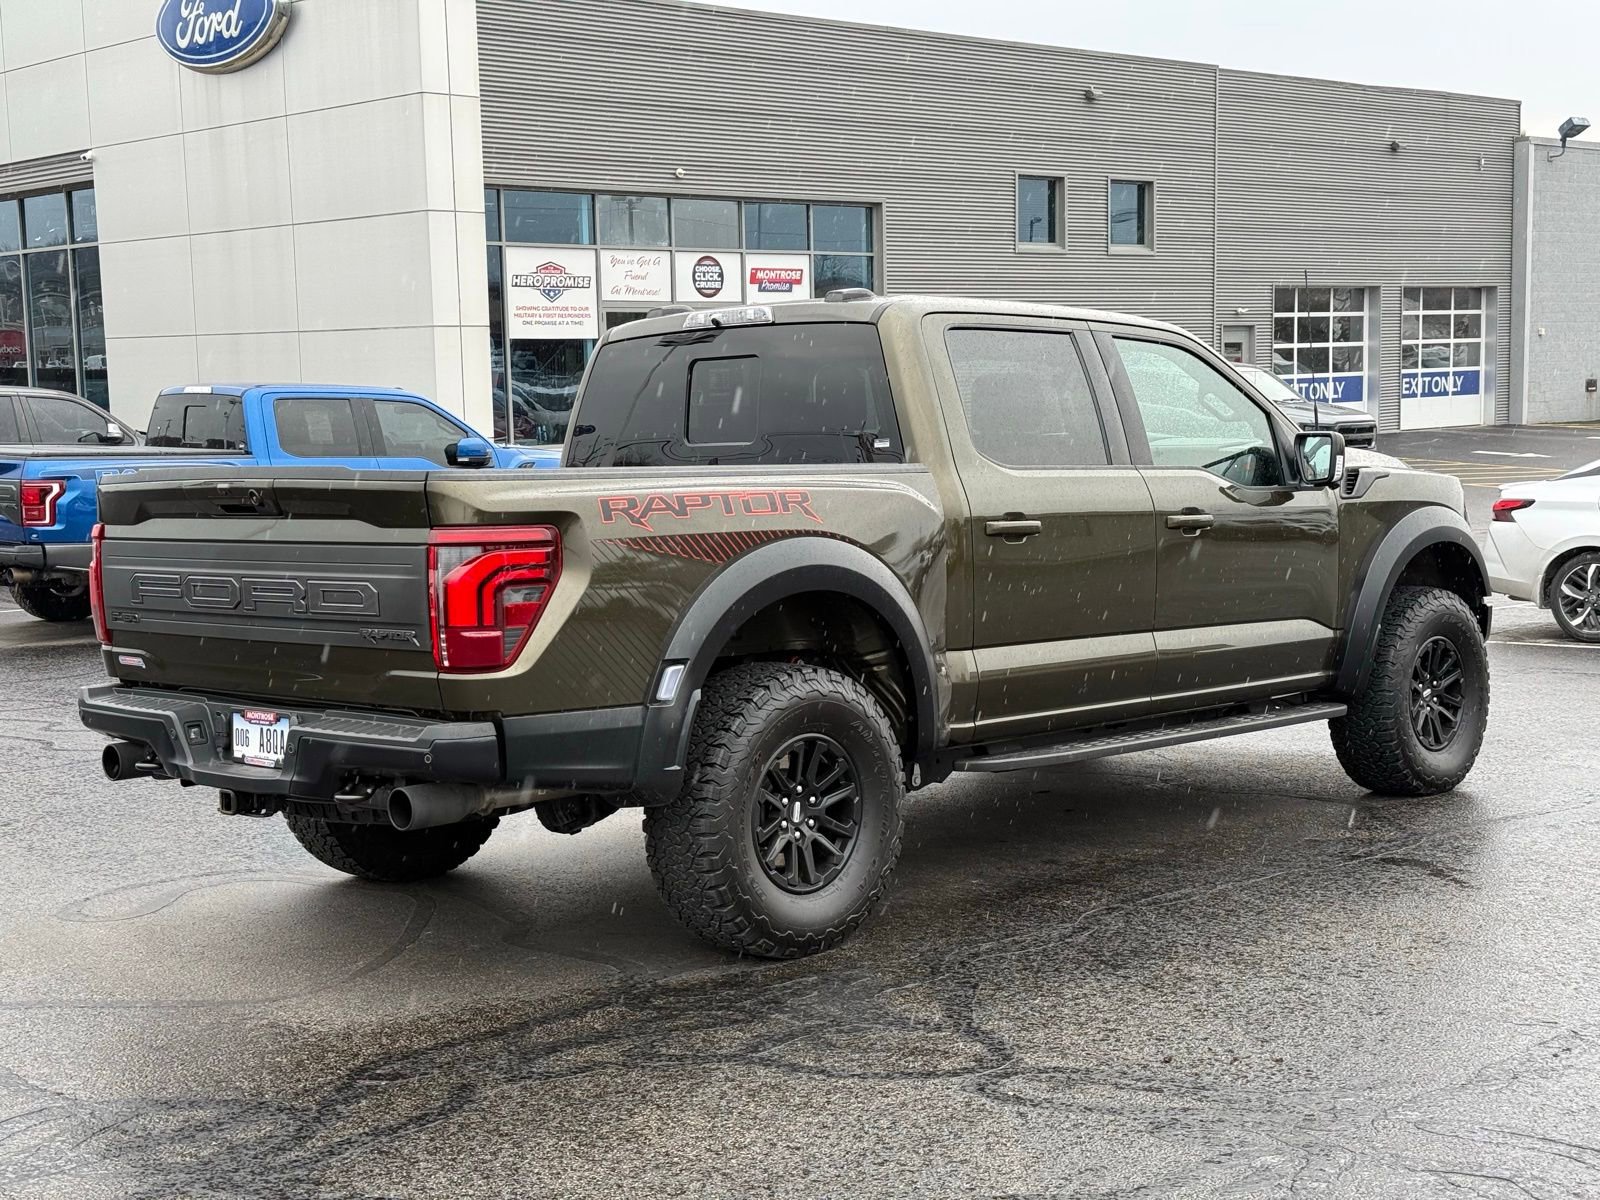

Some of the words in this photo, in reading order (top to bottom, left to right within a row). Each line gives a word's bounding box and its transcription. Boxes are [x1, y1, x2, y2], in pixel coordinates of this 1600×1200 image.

[175, 0, 243, 49] Ford
[512, 275, 541, 287] HERO
[543, 276, 591, 288] PROMISE
[695, 272, 721, 281] CLICK.
[756, 269, 802, 280] MONTROSE
[761, 279, 791, 291] Promise
[1309, 381, 1346, 400] ONLY
[1402, 376, 1432, 395] EXIT
[1431, 375, 1465, 394] ONLY
[597, 490, 824, 531] RAPTOR
[129, 572, 380, 617] FORD
[359, 627, 421, 647] RAPTOR
